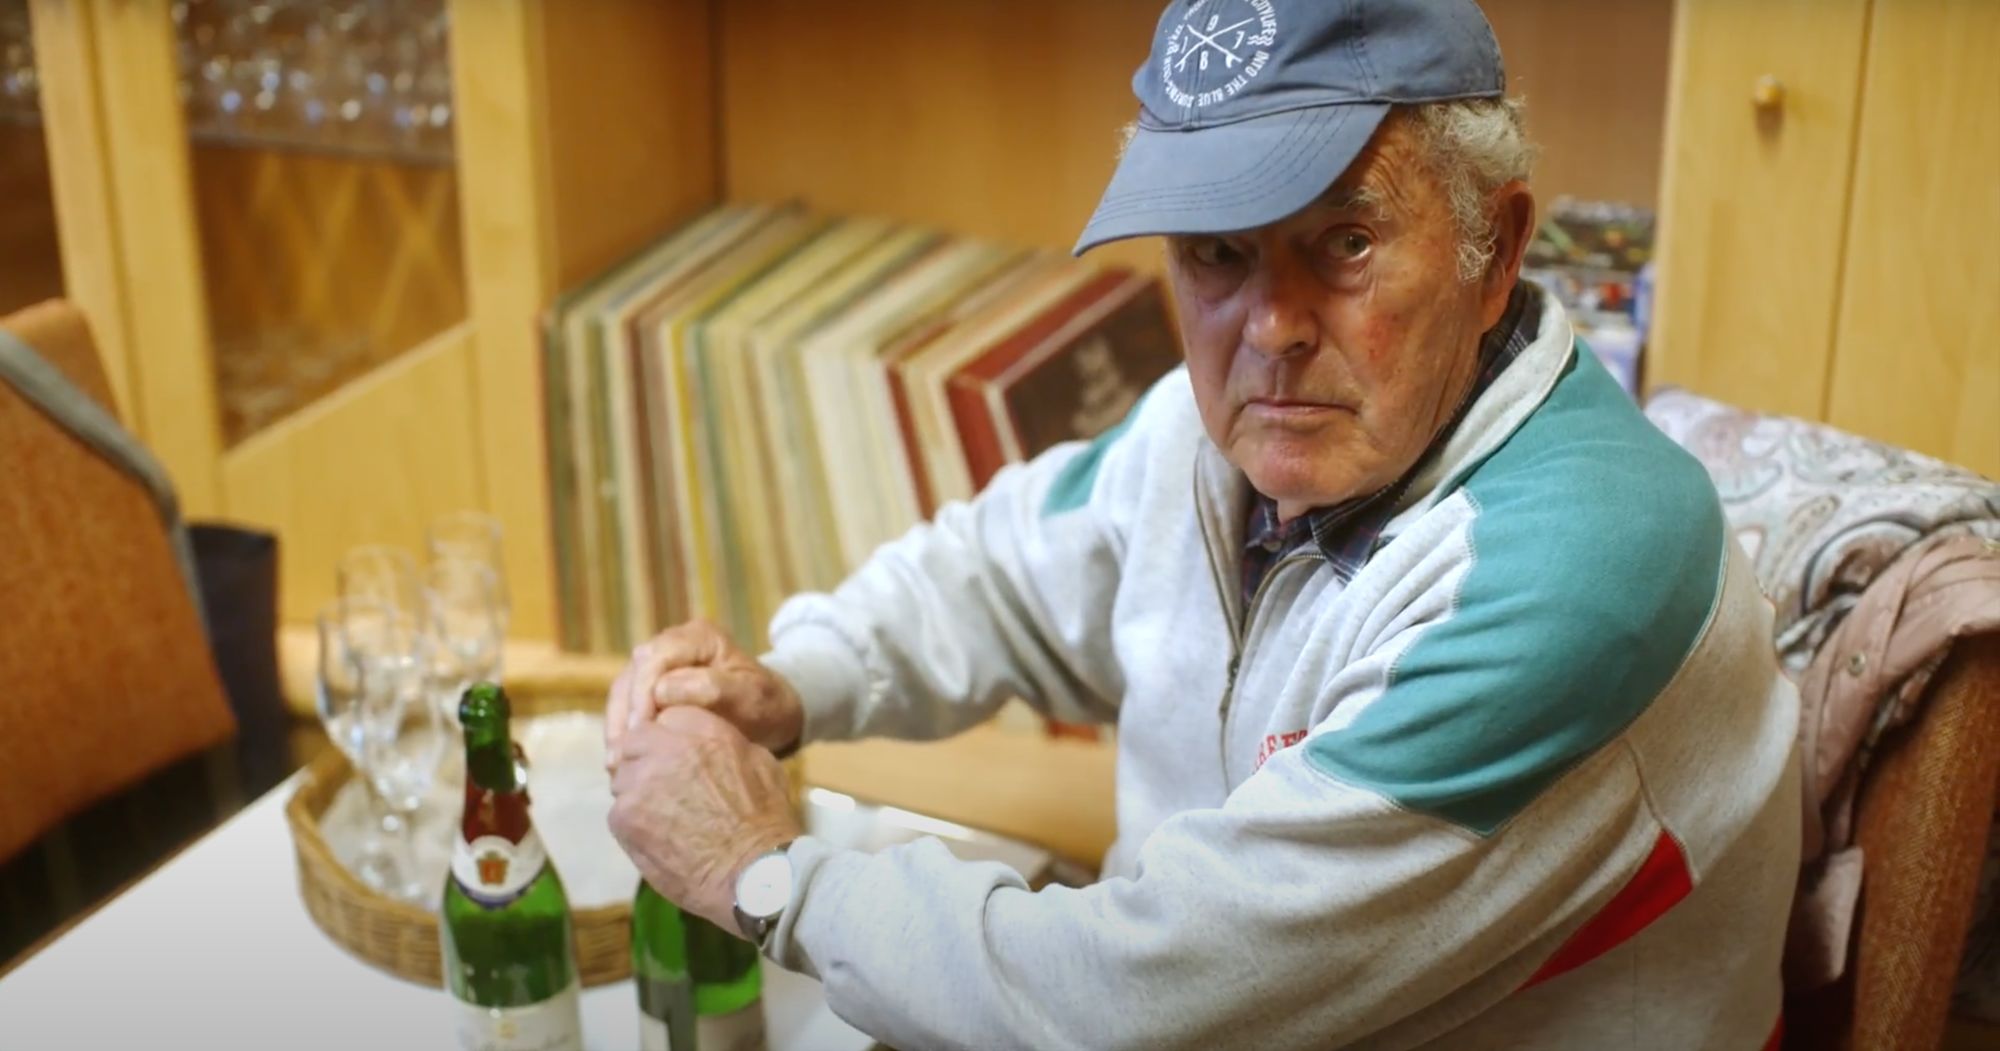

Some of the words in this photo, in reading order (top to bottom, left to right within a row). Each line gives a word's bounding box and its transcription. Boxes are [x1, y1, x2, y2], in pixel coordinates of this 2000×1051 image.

[1245, 50, 1269, 77] INTO
[1224, 74, 1248, 96] THE
[1198, 88, 1223, 107] BLUE
